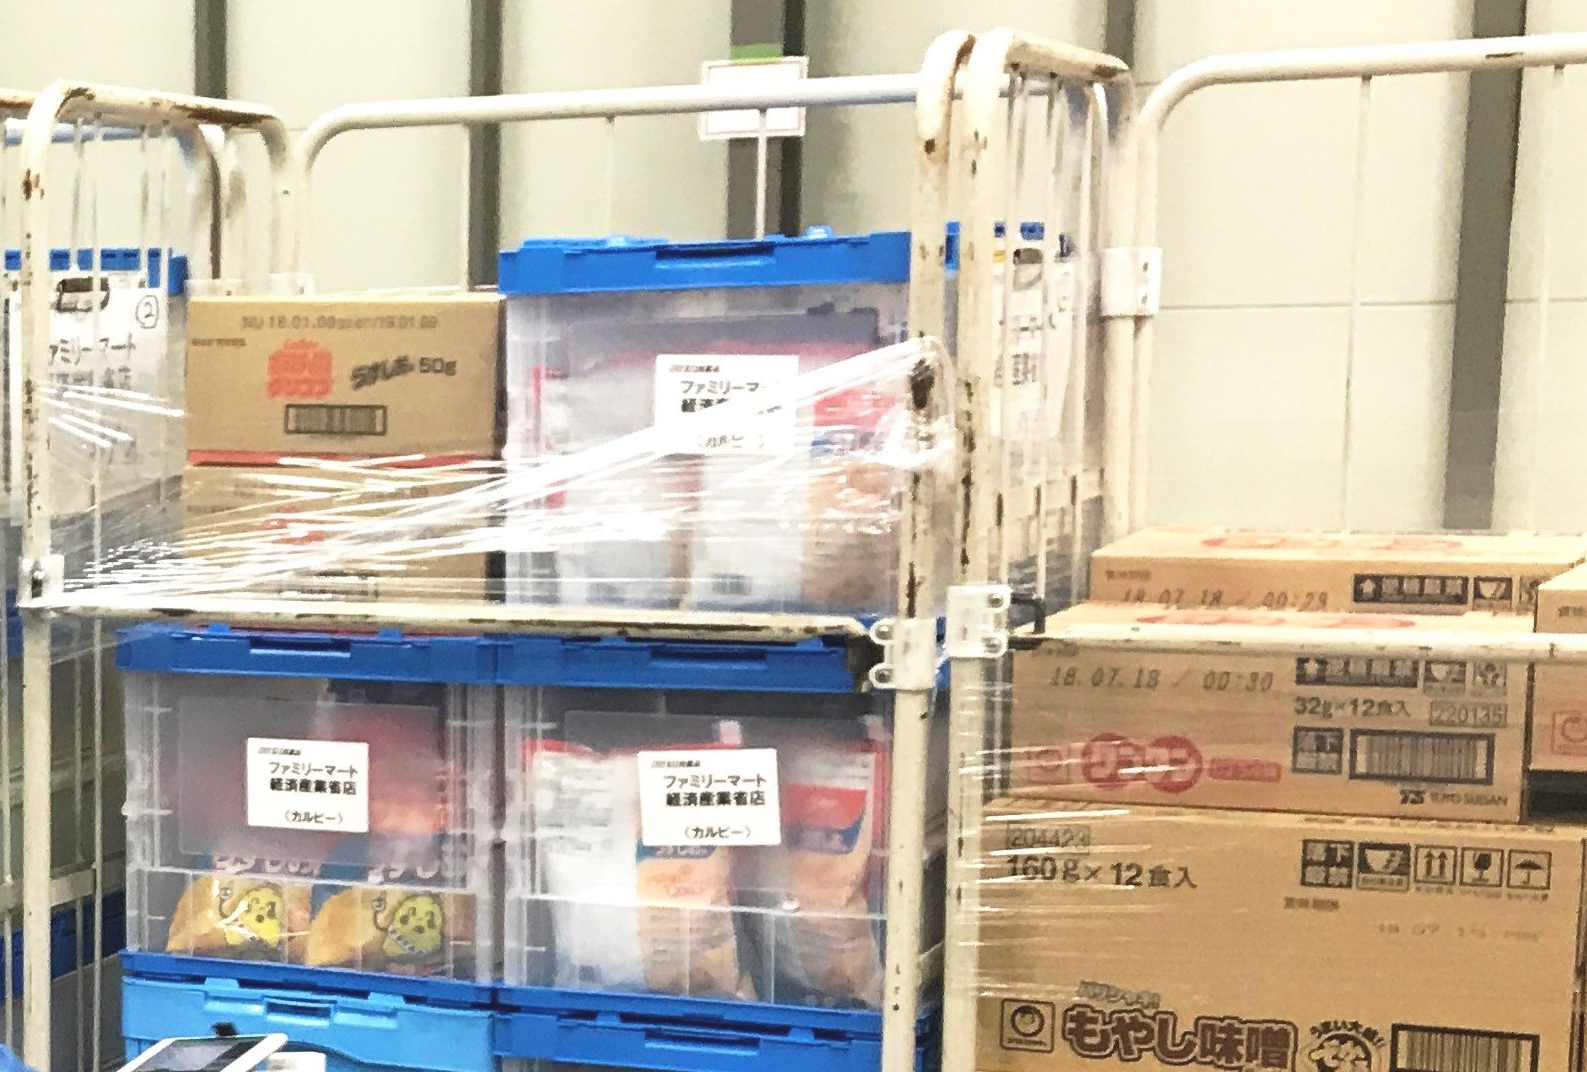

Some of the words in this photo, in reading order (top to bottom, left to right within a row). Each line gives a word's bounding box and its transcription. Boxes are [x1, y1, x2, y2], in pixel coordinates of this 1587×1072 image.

[269, 761, 359, 779] ファミリーマート
[270, 777, 357, 796] 経済産業省店
[663, 773, 767, 789] ファミリーマート
[666, 790, 766, 807] 経済産業省店
[1065, 1006, 1296, 1071] もやし味噌
